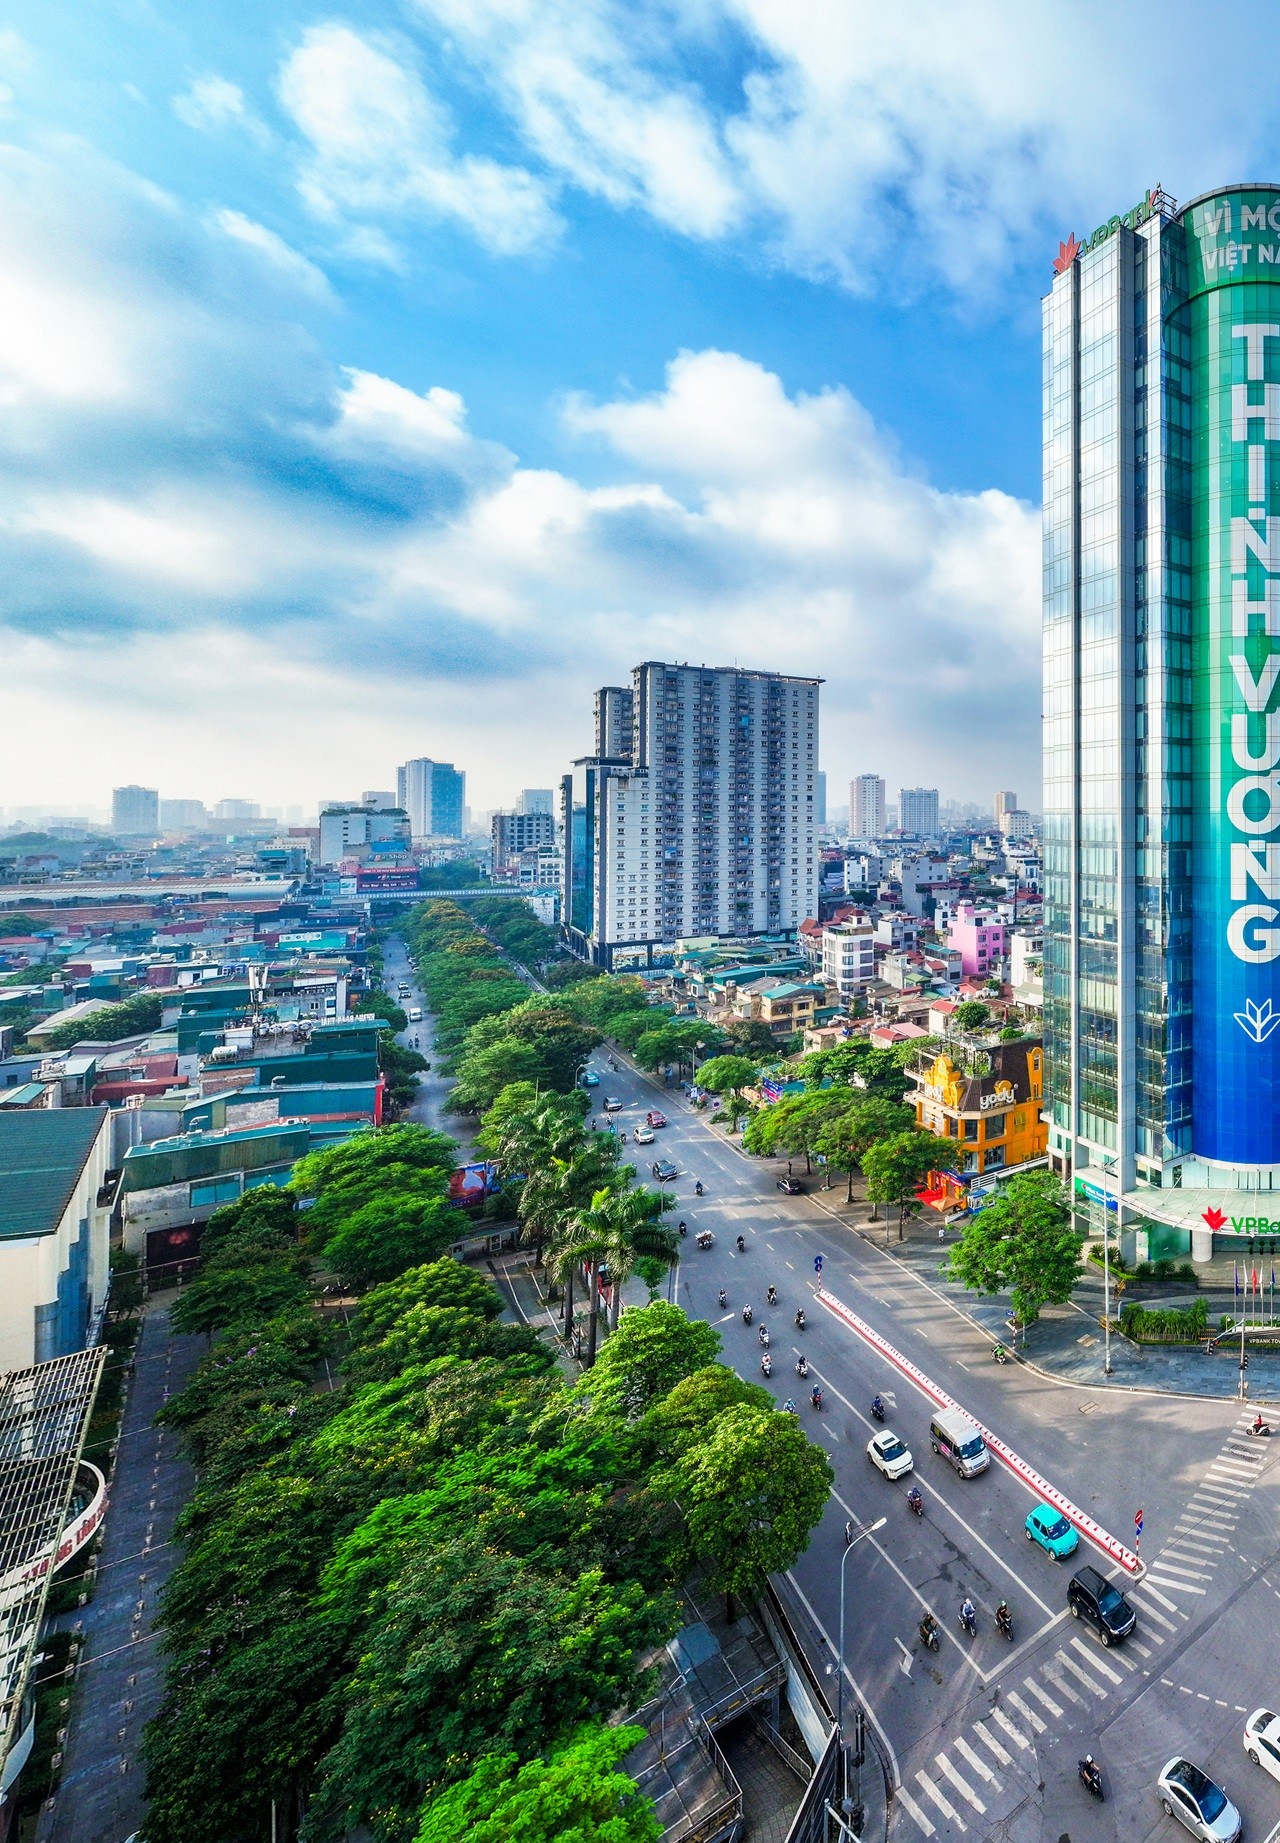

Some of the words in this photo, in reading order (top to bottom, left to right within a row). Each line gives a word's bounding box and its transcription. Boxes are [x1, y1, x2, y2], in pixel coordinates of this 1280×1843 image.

[1082, 189, 1158, 256] VPBank
[1204, 200, 1232, 237] VÌ
[1203, 240, 1252, 272] VIỆT
[980, 1087, 1015, 1110] yody
